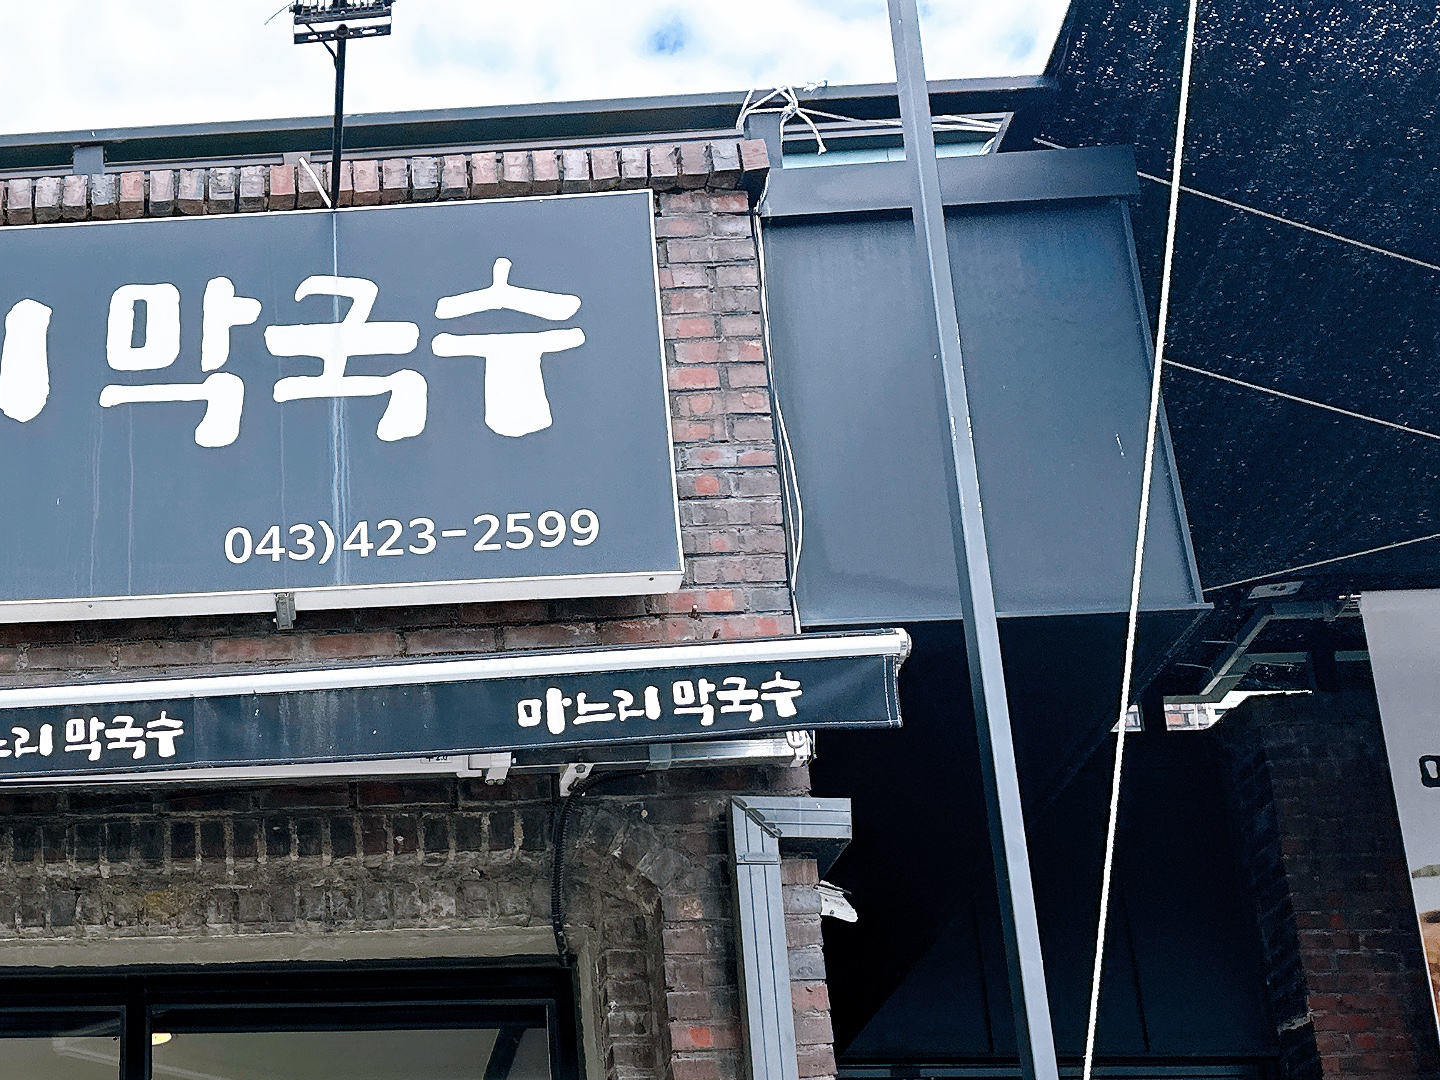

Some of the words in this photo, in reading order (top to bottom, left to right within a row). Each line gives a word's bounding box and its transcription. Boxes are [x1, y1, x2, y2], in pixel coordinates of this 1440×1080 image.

[98, 256, 587, 449] 막국수
[223, 508, 601, 567] 043)423-2599
[516, 686, 661, 735] 마느리
[671, 670, 803, 726] 막국수
[63, 710, 185, 762] 막국수
